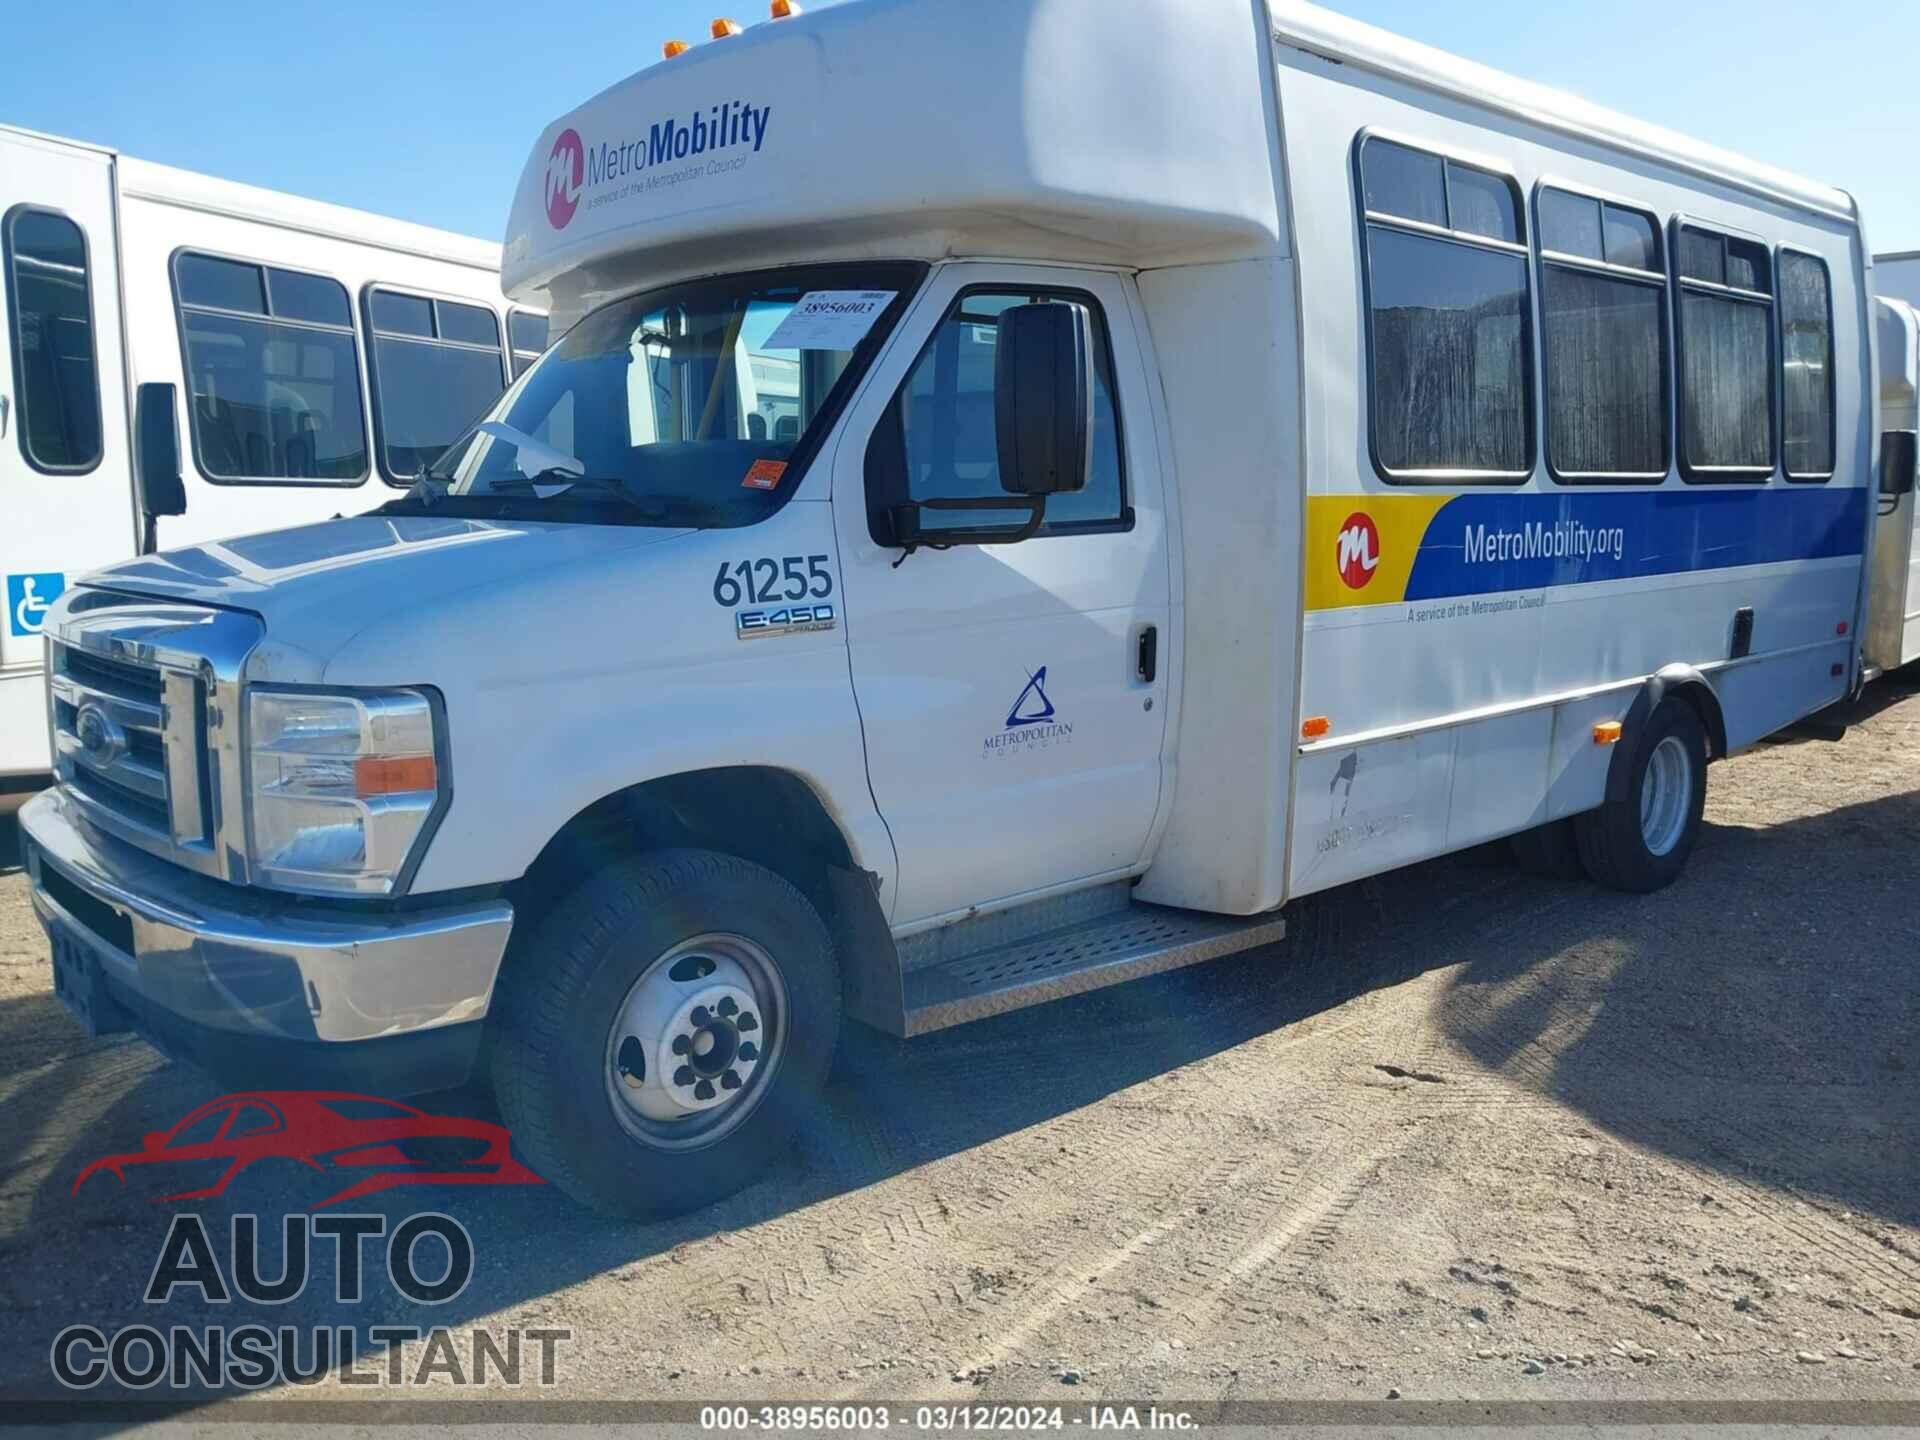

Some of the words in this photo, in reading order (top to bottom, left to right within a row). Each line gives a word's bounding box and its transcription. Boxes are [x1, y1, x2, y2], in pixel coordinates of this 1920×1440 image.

[588, 101, 770, 187] MetroMobility
[799, 302, 875, 314] 38956003
[1463, 520, 1624, 563] MetroMobility.org
[713, 555, 833, 607] 61255
[1407, 608, 1414, 623] A
[1415, 609, 1446, 622] service
[1447, 604, 1456, 618] of
[1457, 602, 1469, 616] the
[1471, 597, 1517, 616] Metropolitan
[1519, 593, 1546, 609] Council
[983, 723, 1073, 750] METROPOLITAN
